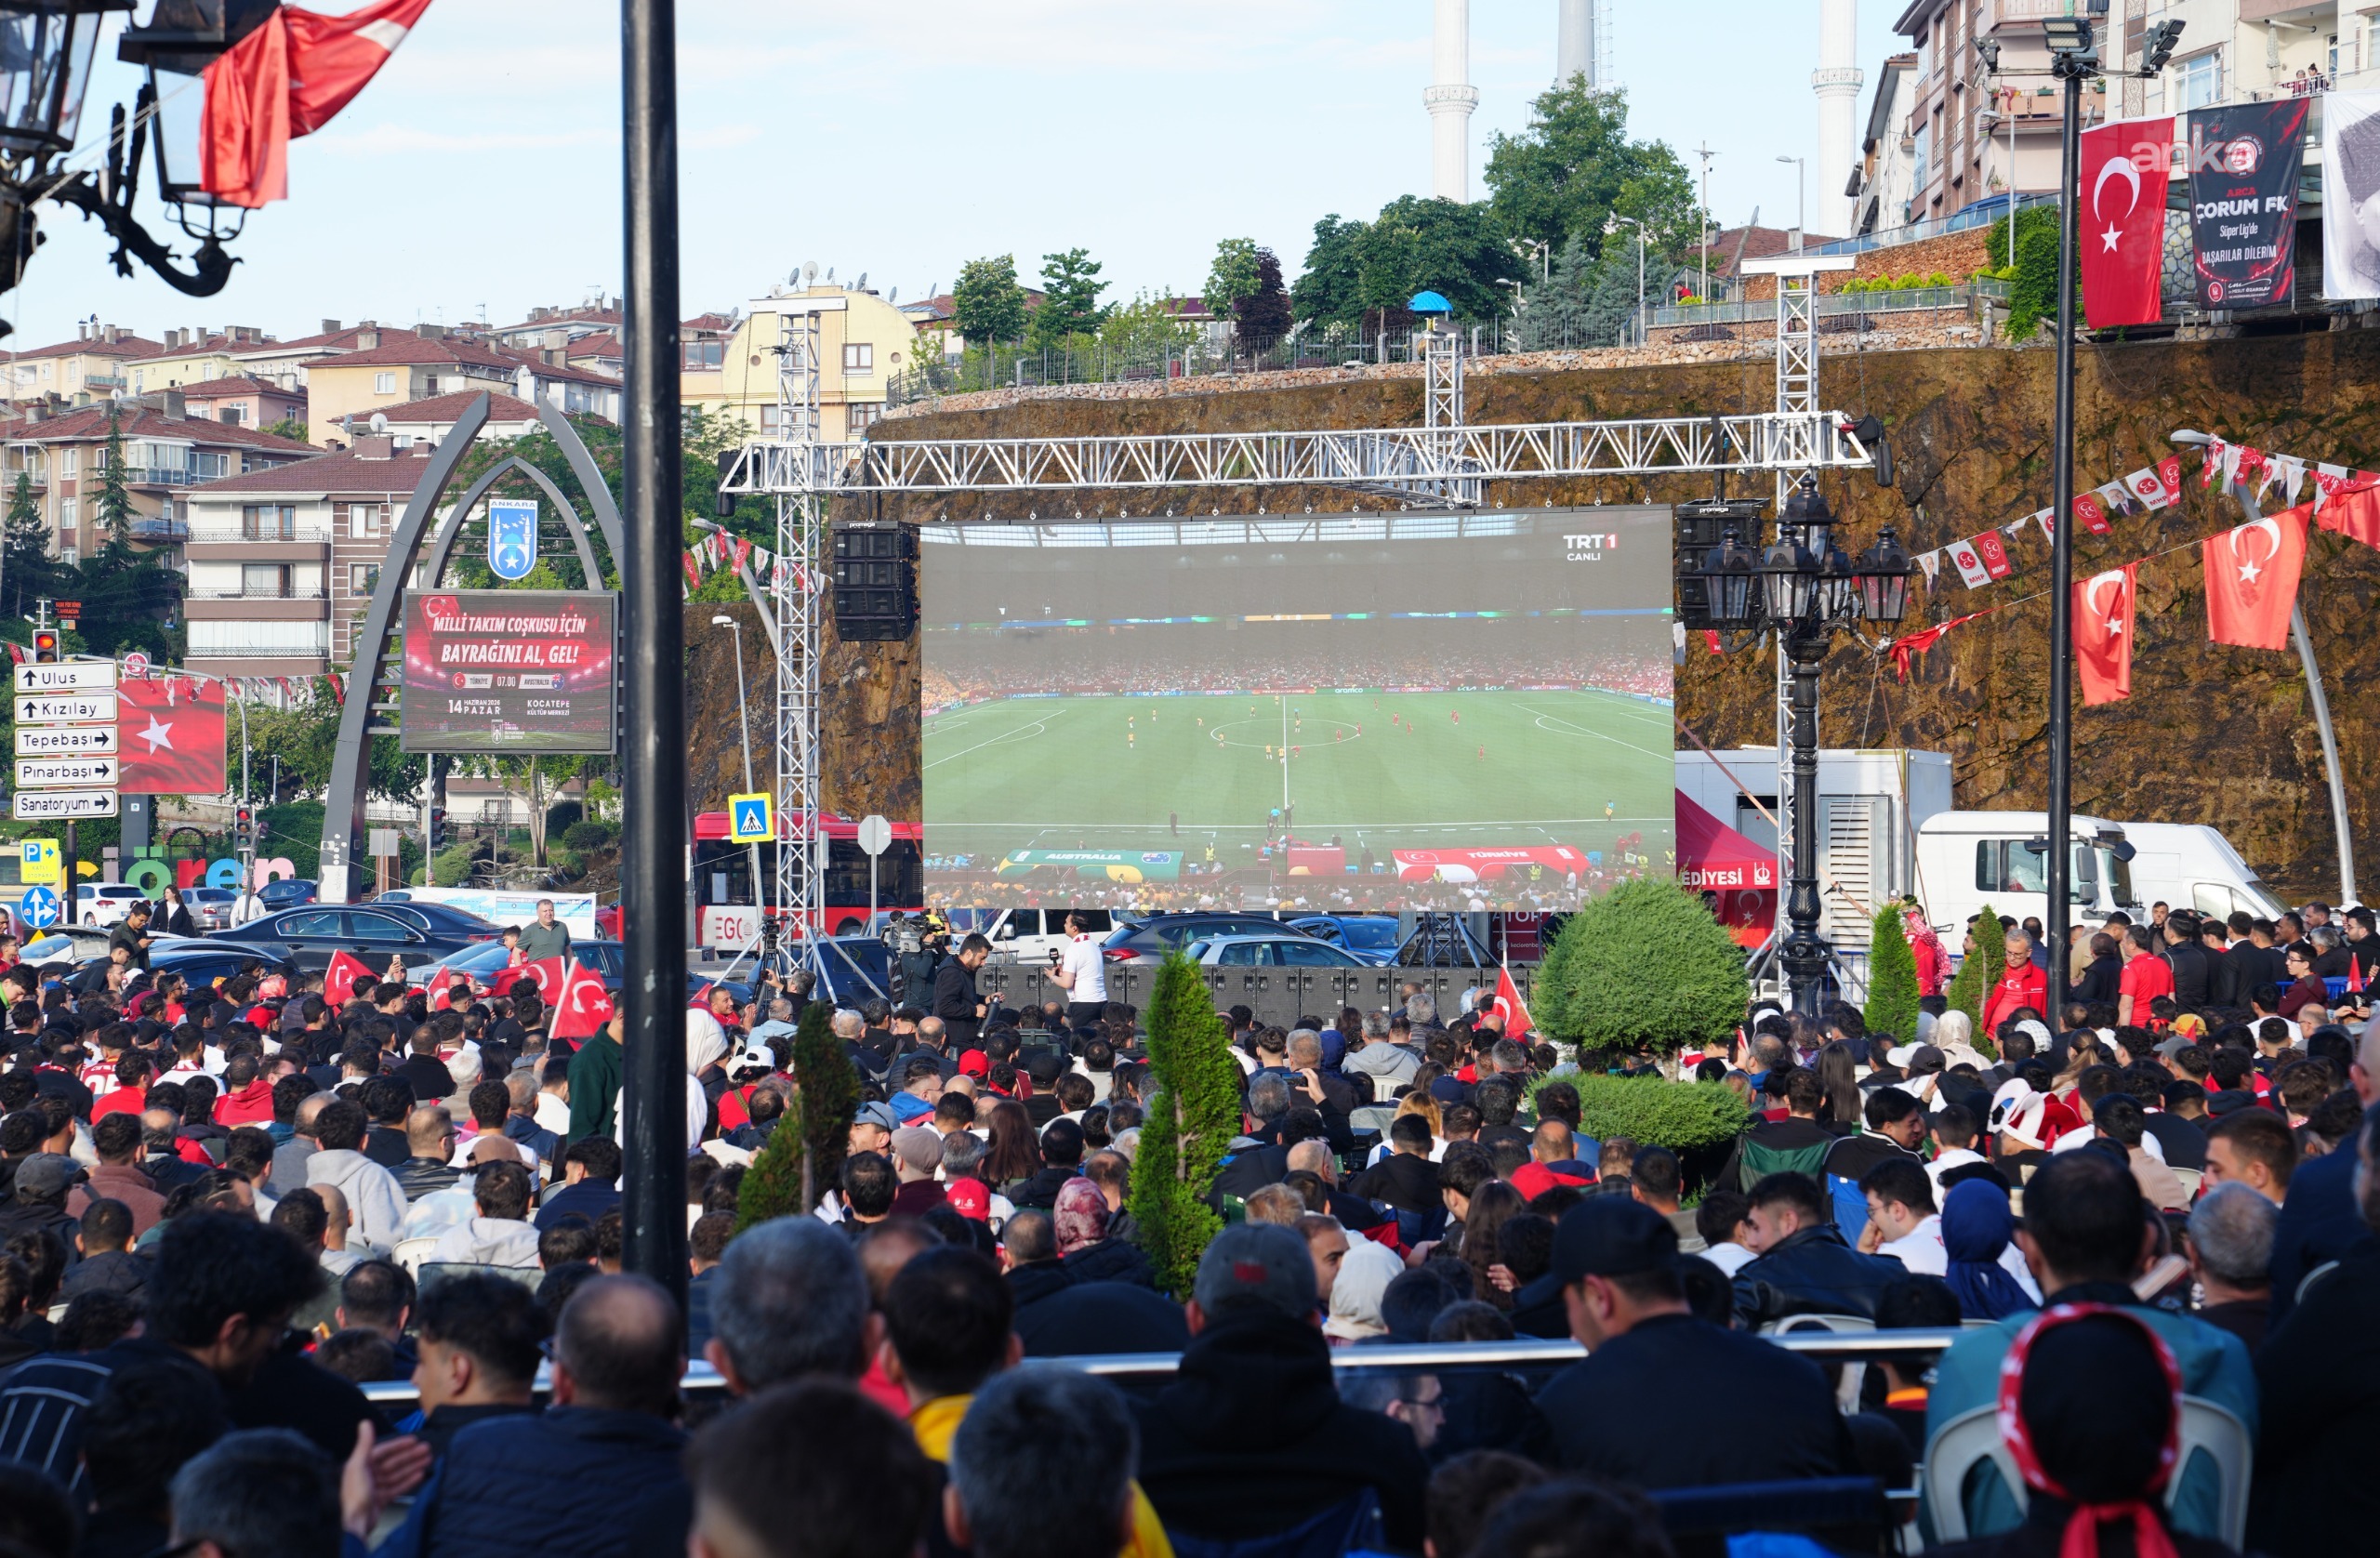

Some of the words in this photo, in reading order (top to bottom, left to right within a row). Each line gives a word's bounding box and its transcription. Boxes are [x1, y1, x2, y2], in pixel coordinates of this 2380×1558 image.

[2226, 186, 2257, 197] ARCA
[2195, 198, 2259, 224] ÇORUM
[2265, 194, 2290, 213] FK
[2219, 224, 2239, 240] Süper
[2202, 247, 2242, 267] BAŞARILAR
[2244, 244, 2277, 260] DİLERİM
[2149, 495, 2168, 507] MHP
[1567, 552, 1602, 561] CANLI
[1991, 564, 2006, 574] MHP
[1968, 574, 1985, 584] MHP
[432, 612, 468, 633] MİLLİ
[469, 616, 507, 633] TAKIM
[507, 616, 557, 637] COŞKUSU
[557, 613, 587, 637] İÇİN
[441, 639, 522, 664] BAYRAĞINI
[523, 645, 545, 666] AL,
[549, 645, 579, 664] GEL!
[42, 672, 76, 685] Ulus
[469, 676, 488, 685] TÜRKİYE
[496, 676, 516, 687] 07.00
[42, 702, 97, 717] Kızılay
[448, 699, 463, 714] 14
[526, 699, 570, 707] KOCATEPE
[464, 706, 501, 715] PAZAR
[23, 733, 93, 749] Tepebaşı
[23, 765, 91, 779] Pınarbaşı
[20, 798, 90, 814] Sanatoryum
[1466, 851, 1529, 859] TÜRKİYE
